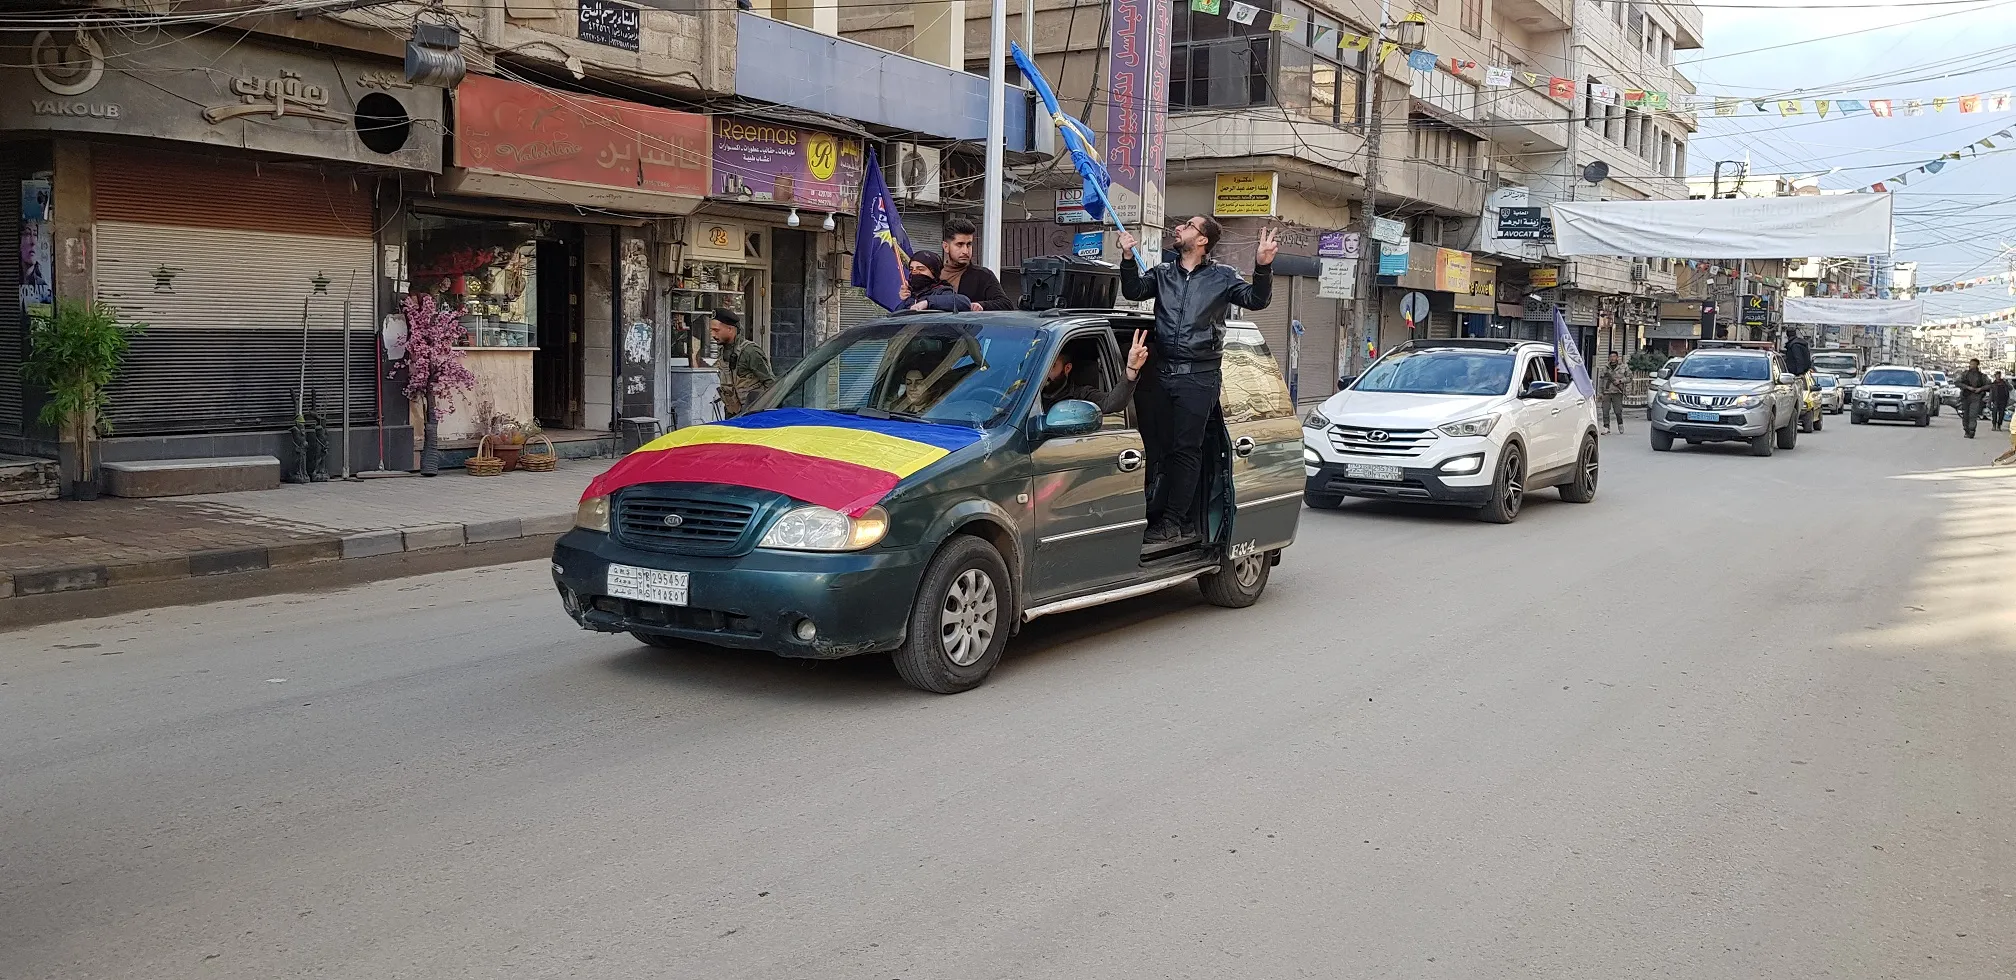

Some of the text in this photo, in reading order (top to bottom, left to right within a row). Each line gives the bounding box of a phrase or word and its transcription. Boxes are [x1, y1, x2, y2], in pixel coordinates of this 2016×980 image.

[229, 69, 330, 120] يعقوب
[31, 99, 122, 120] YAKOUB
[719, 118, 798, 146] Reemas
[1110, 71, 1138, 181] للكمبيوتر
[495, 141, 583, 164] Valentine
[810, 139, 833, 170] R
[1059, 189, 1083, 201] ICD
[1503, 230, 1533, 238] AVOCAT
[1231, 538, 1256, 559] FX4
[651, 572, 688, 587] 295452
[652, 588, 686, 603] ٢٩٥٤٥٢
